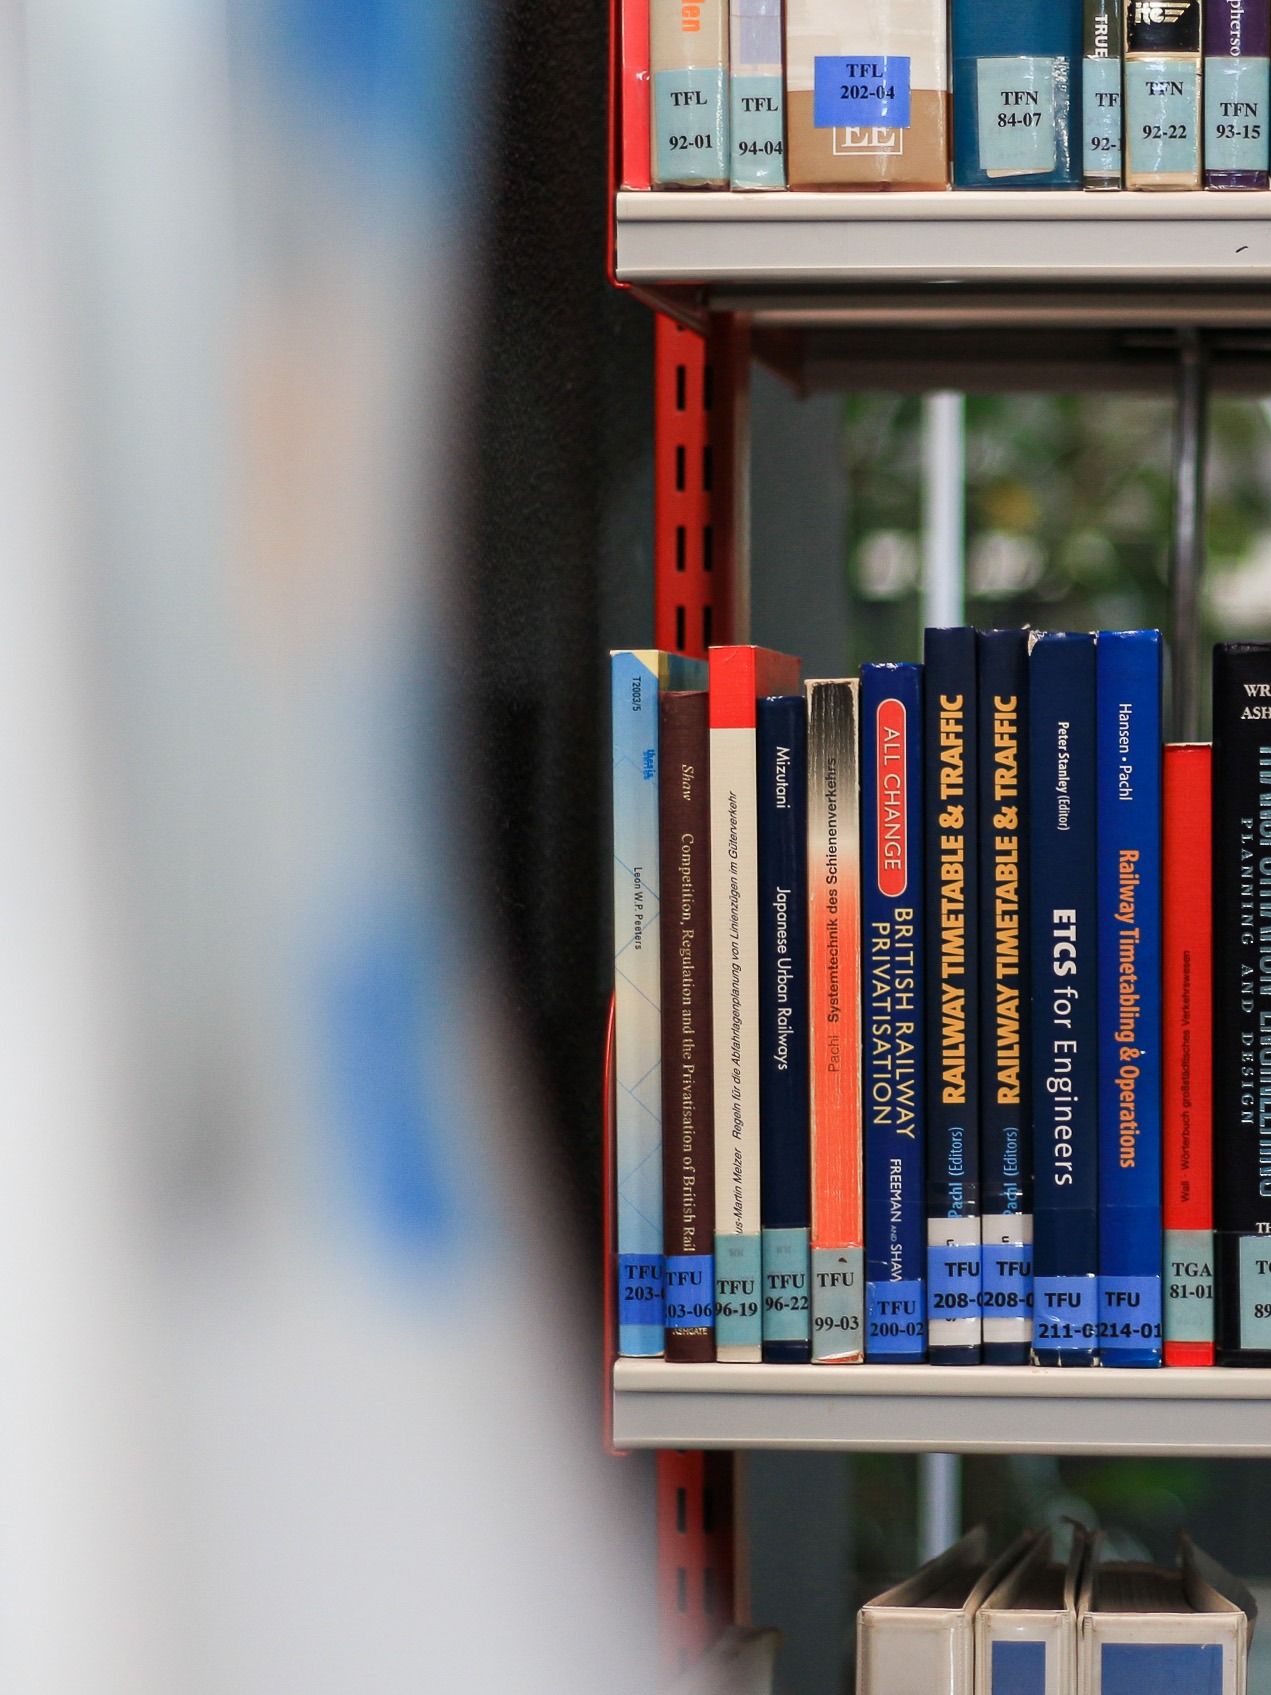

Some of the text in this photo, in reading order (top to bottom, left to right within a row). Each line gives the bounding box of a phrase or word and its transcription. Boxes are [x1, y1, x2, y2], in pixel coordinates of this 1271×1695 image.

[846, 63, 884, 79] TFL
[840, 85, 895, 100] 202-04
[1146, 81, 1184, 96] TFN
[671, 90, 708, 107] TFL
[742, 97, 779, 112] TFL
[1001, 91, 1039, 106] TFN
[1220, 103, 1258, 117] TFN
[997, 112, 1042, 127] 84-07
[1143, 124, 1187, 139] 92-22
[1216, 125, 1261, 139] 93-15
[669, 134, 713, 150] 92-01
[738, 140, 783, 156] 94-04
[632, 676, 642, 711] T2003/5
[1119, 703, 1132, 753] Hansen
[682, 764, 694, 801] Shaw
[776, 746, 790, 809] Mizutani
[883, 727, 902, 870] ALL CHANGE
[728, 791, 740, 940] Linienzügen Güterverkehr
[633, 867, 643, 890] Leon
[825, 757, 841, 1023] Systemtechnik des Schienenverkehrs
[940, 694, 965, 1104] RAILWAY TIMETABLE TRAFFIC
[994, 695, 1020, 1104] RAILWAY TIMETABLE TRAFFIC
[633, 914, 643, 950] Peeters
[773, 887, 793, 1070] Japanese Urban Railways
[1241, 817, 1254, 1124] PLANNING DESIGN
[1114, 850, 1140, 1168] Railway Timetabling Operations
[872, 922, 892, 1124] PRIVATISATION
[895, 908, 915, 1139] BRITISH RAILWAY
[680, 833, 695, 1252] Competition, Regulation Privatisation British Rail
[1046, 909, 1079, 1186] ETCS for Engineers
[890, 1158, 902, 1222] FREEMAN
[945, 1261, 980, 1277] TFU
[996, 1261, 1031, 1277] TFU
[1172, 1262, 1212, 1278] TGA
[717, 1280, 755, 1295] TFU
[768, 1274, 806, 1289] TFU
[817, 1272, 855, 1288] TFU
[1105, 1291, 1140, 1308] TFU
[1169, 1284, 1213, 1299] 81-01
[765, 1296, 809, 1311] 96-22
[877, 1300, 917, 1316] TFU
[1044, 1292, 1081, 1308] TFU
[715, 1302, 758, 1317] 96-19
[815, 1315, 859, 1331] 99-03
[870, 1321, 924, 1337] 200-02
